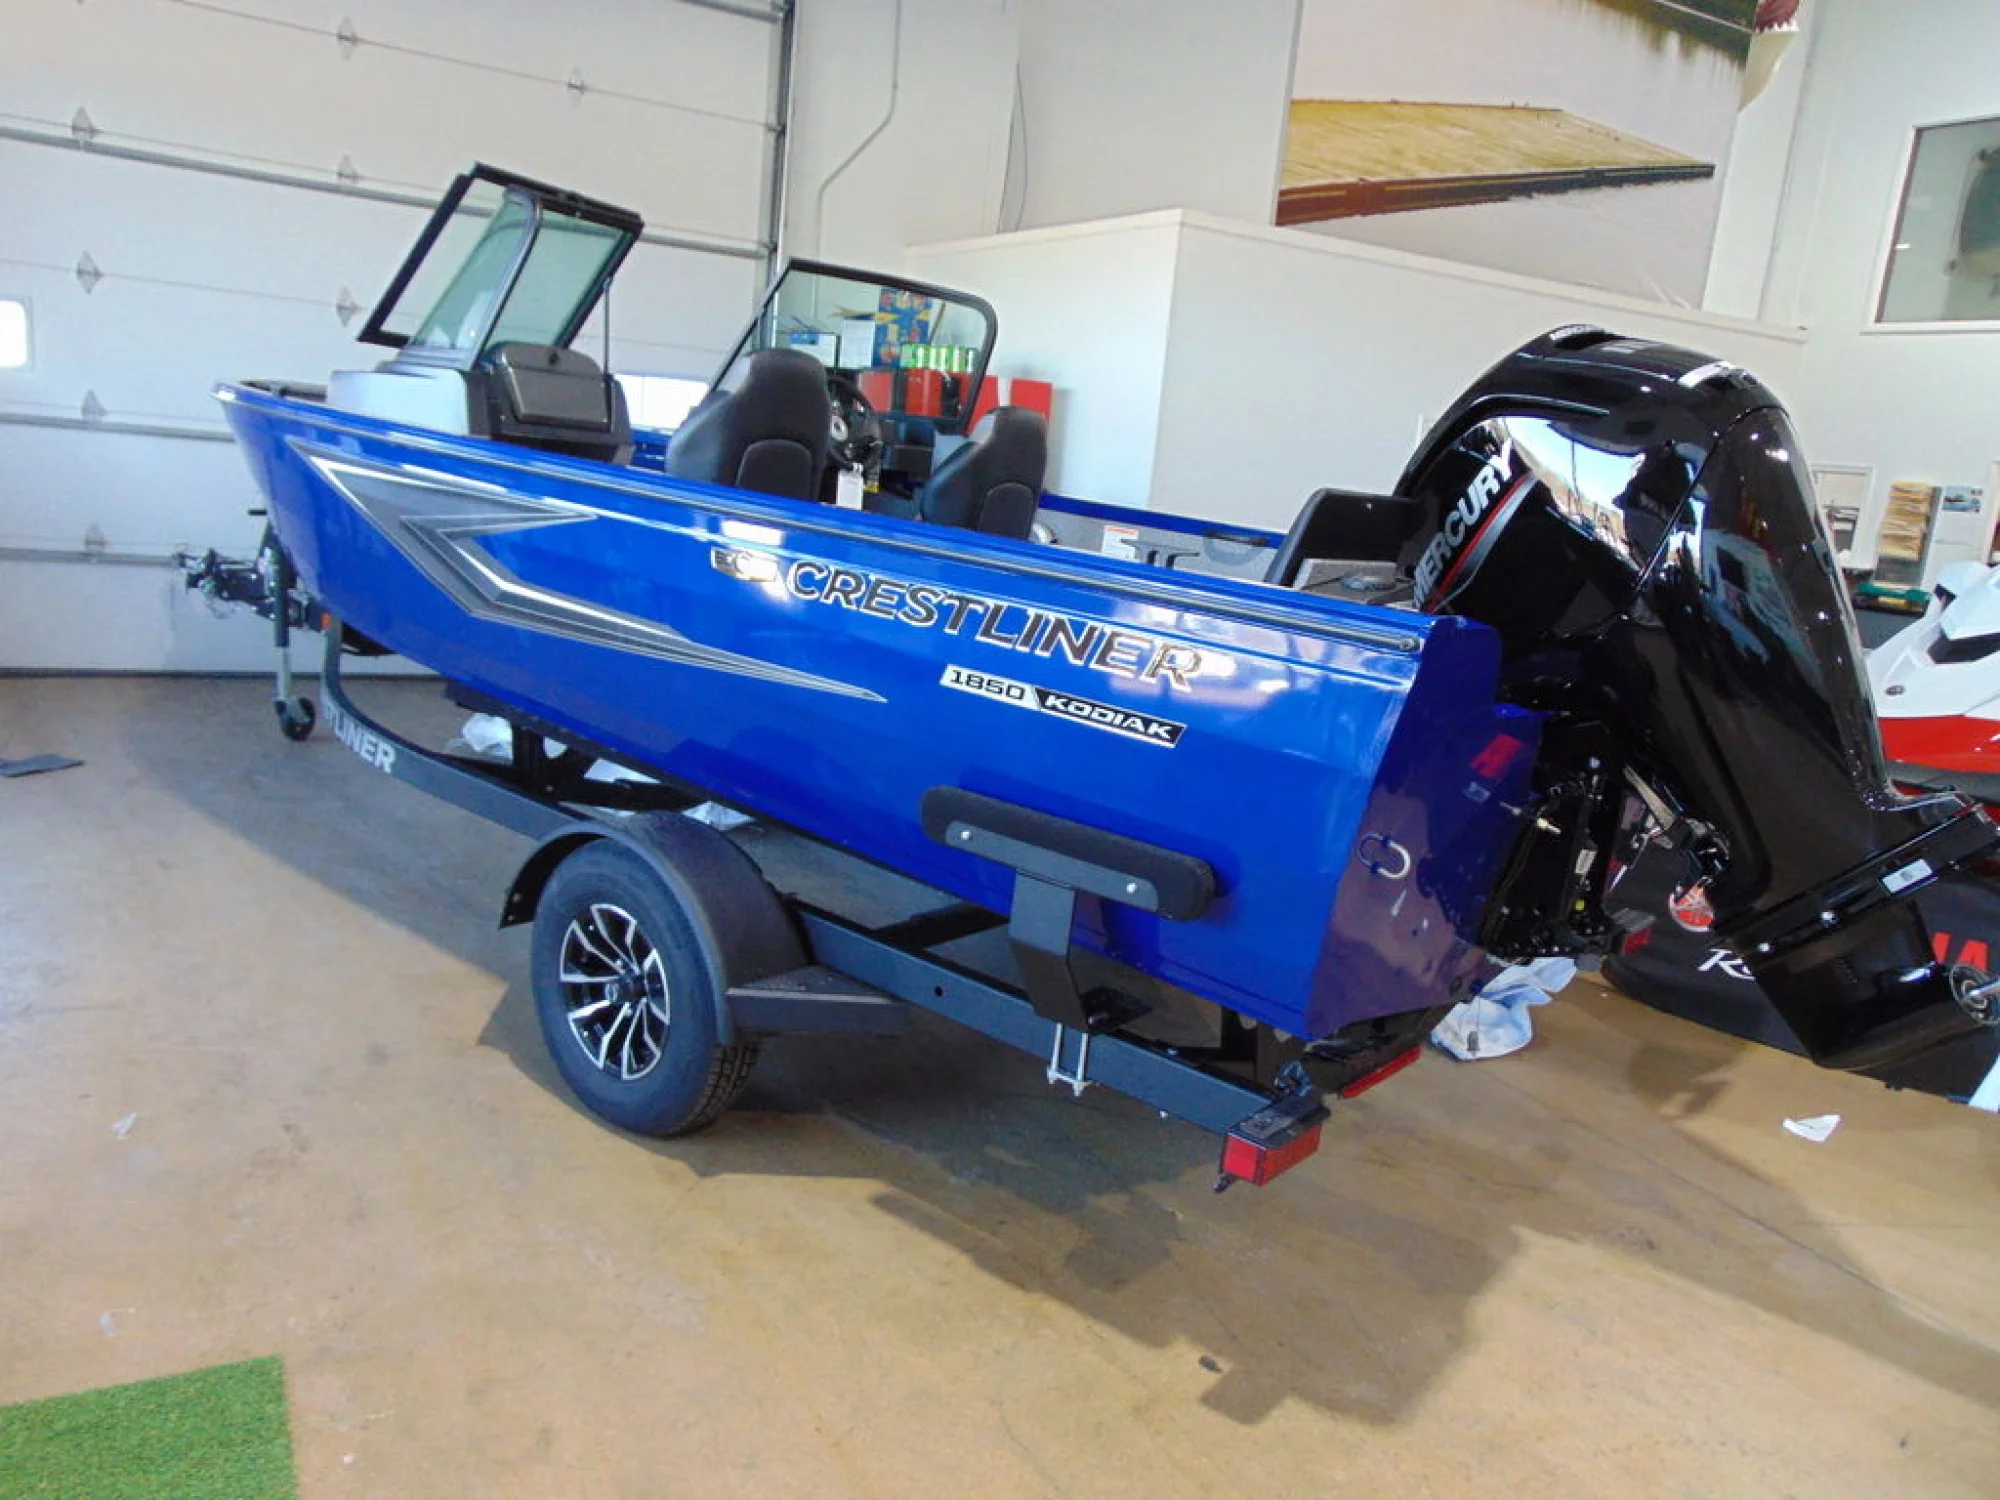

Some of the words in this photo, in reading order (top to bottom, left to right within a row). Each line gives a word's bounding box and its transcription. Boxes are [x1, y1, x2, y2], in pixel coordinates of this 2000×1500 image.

[1414, 436, 1513, 611] MERCURY
[787, 560, 1204, 694] CRESTLINER
[330, 706, 396, 774] LINER
[949, 667, 1025, 702] 1850
[1045, 693, 1174, 740] KODIAK
